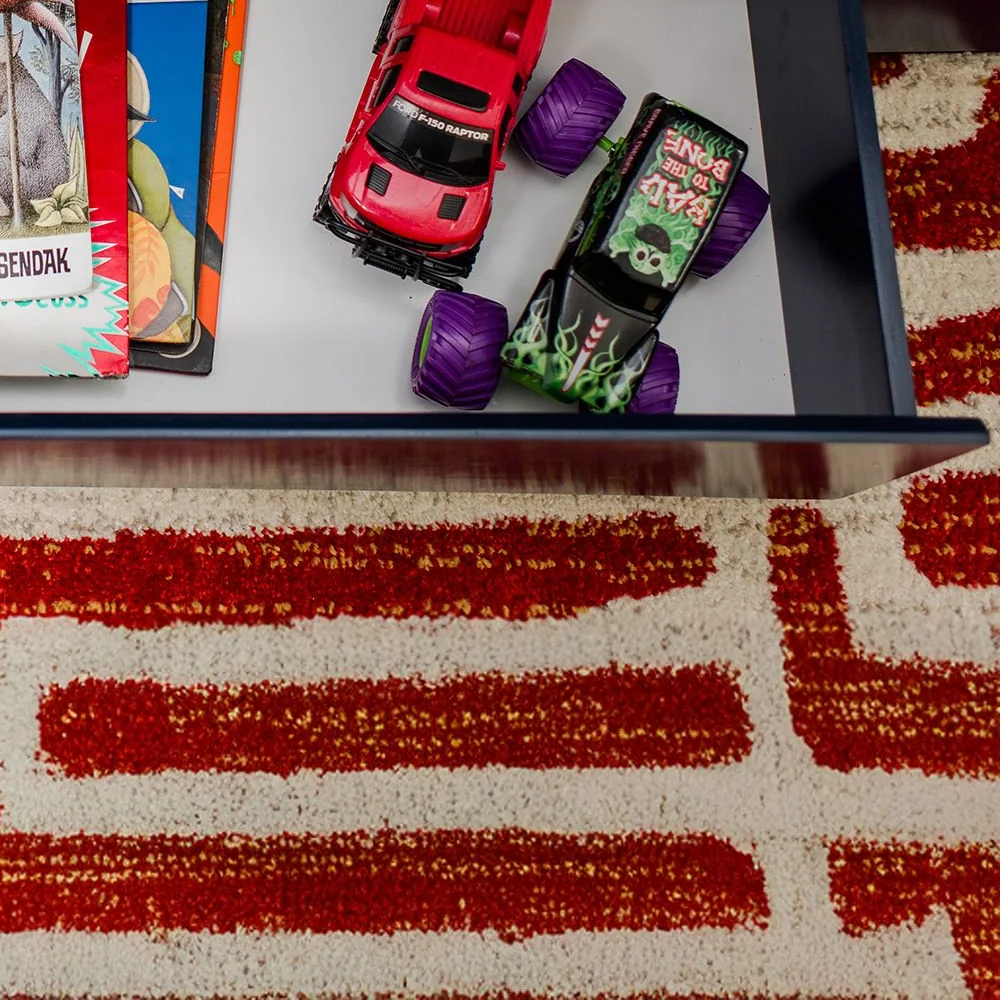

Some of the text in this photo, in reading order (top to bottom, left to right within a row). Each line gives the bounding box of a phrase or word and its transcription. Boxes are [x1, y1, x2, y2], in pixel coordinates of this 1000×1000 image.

[392, 100, 489, 141] FORD F-150 RAPTOR
[660, 156, 711, 192] TO THE
